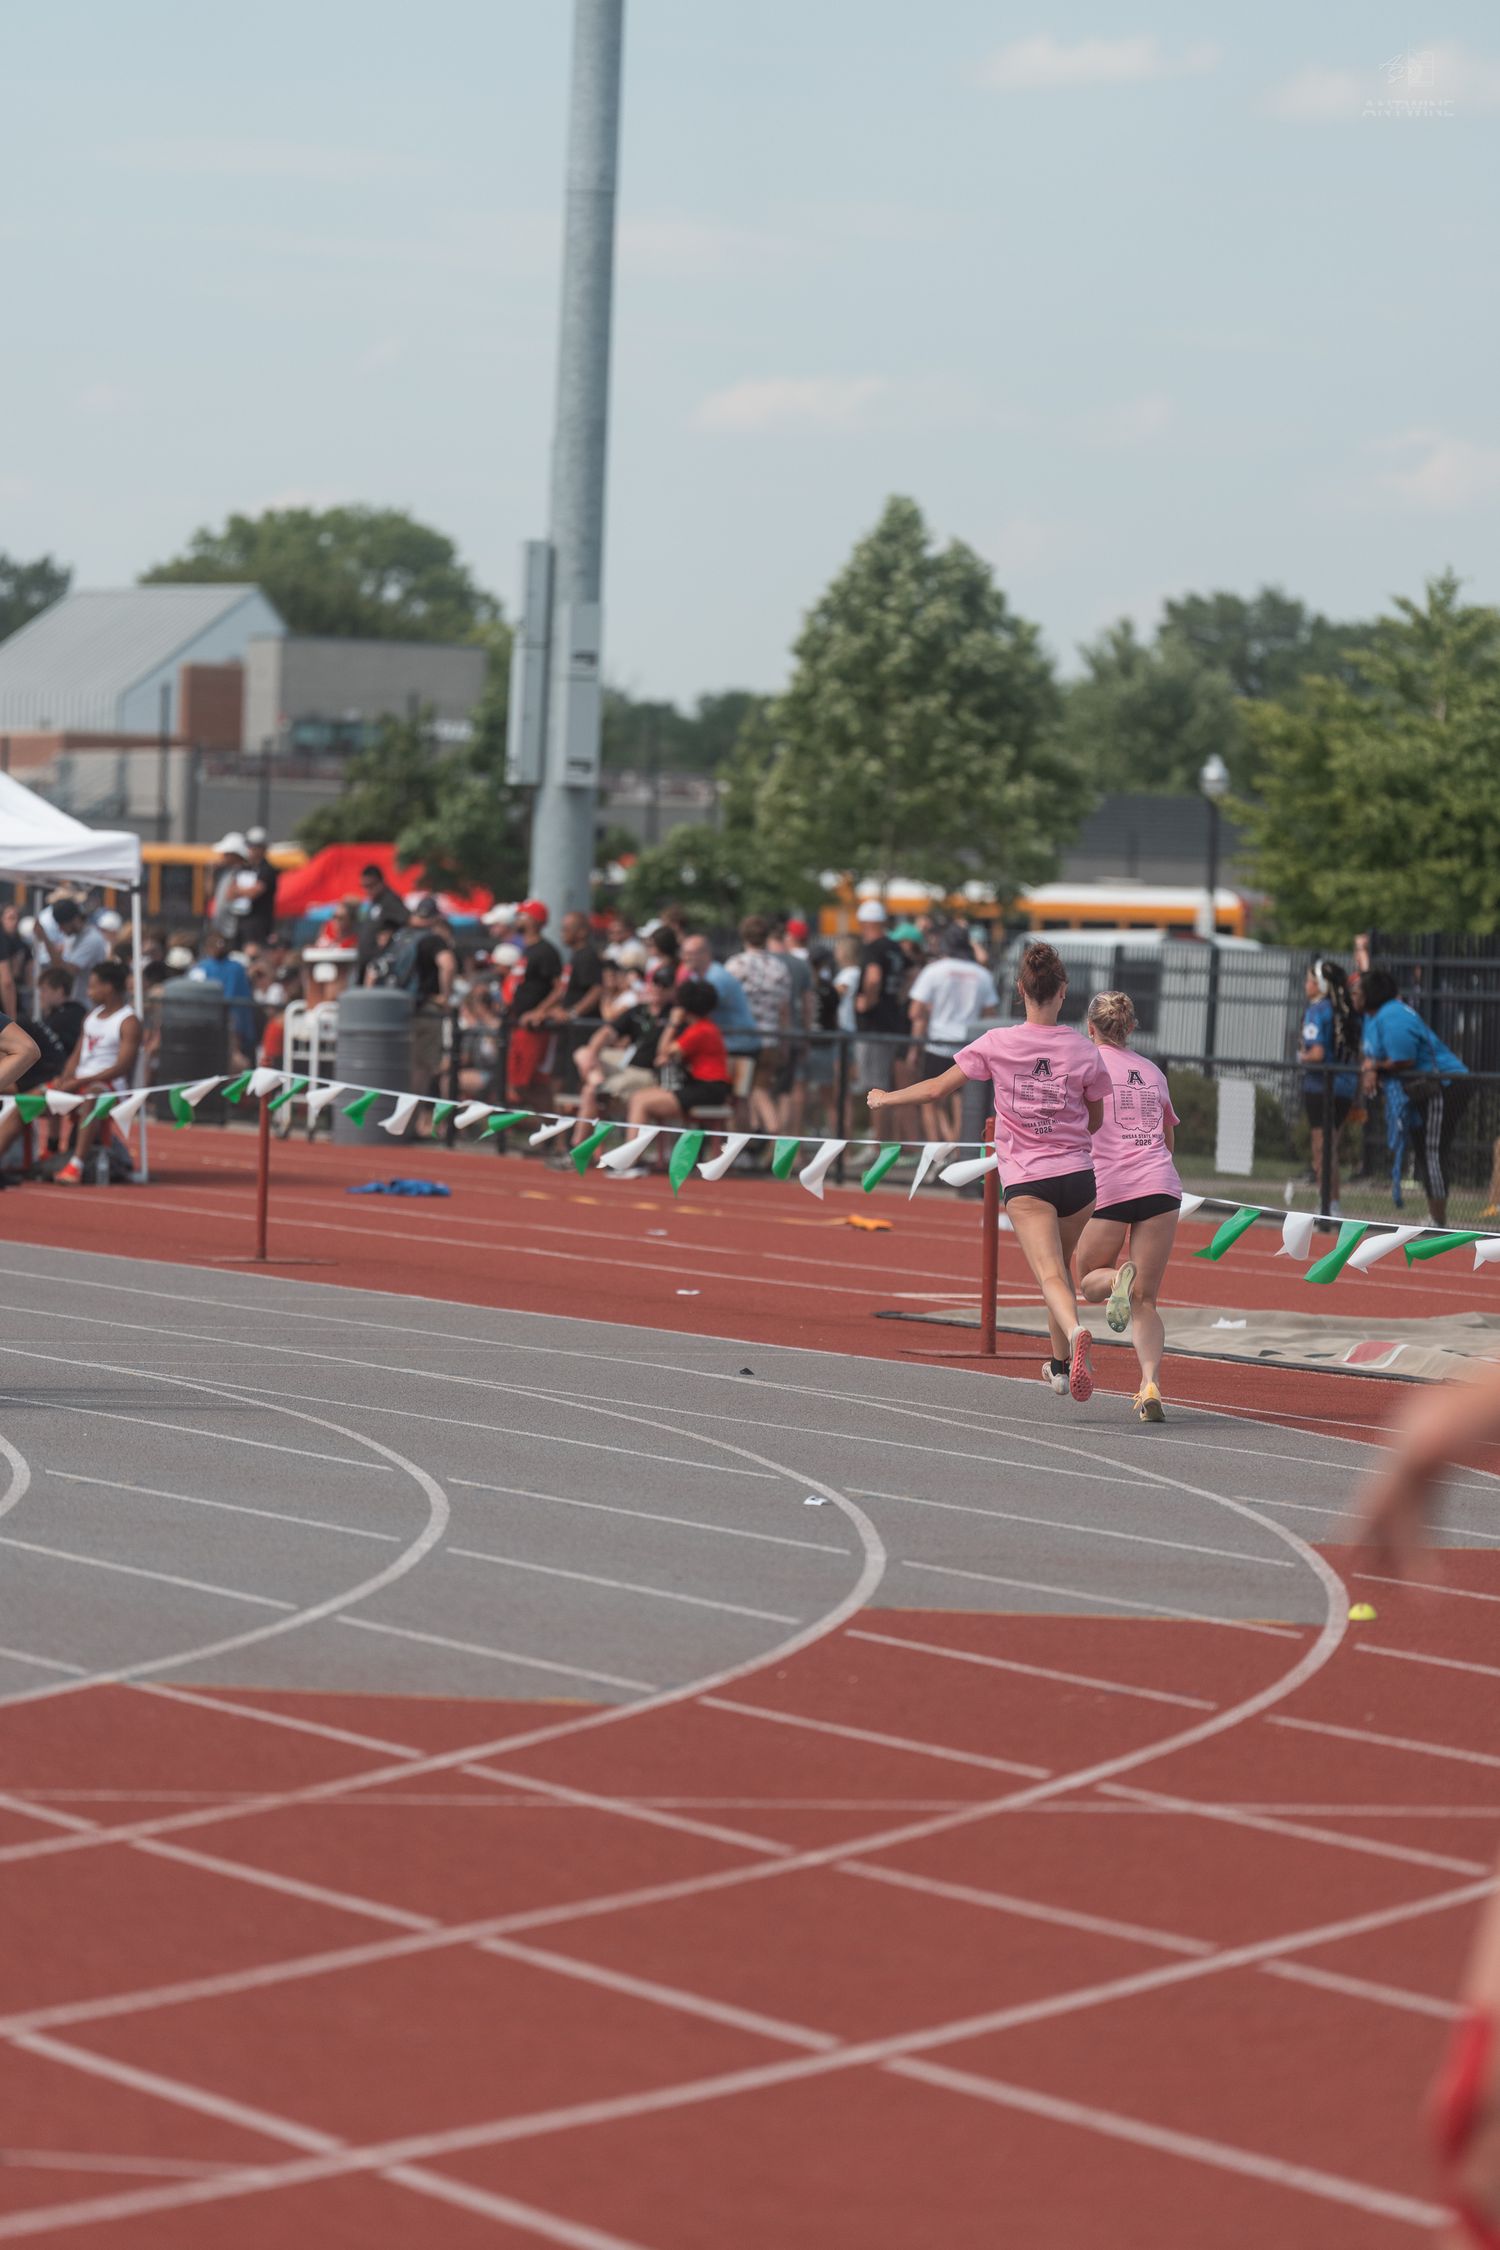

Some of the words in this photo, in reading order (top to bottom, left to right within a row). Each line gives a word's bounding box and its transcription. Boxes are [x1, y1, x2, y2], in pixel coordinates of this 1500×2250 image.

[1032, 1058, 1052, 1077] A
[1127, 1070, 1145, 1085] A
[1034, 1126, 1053, 1135] 2026
[1135, 1138, 1153, 1146] 2026
